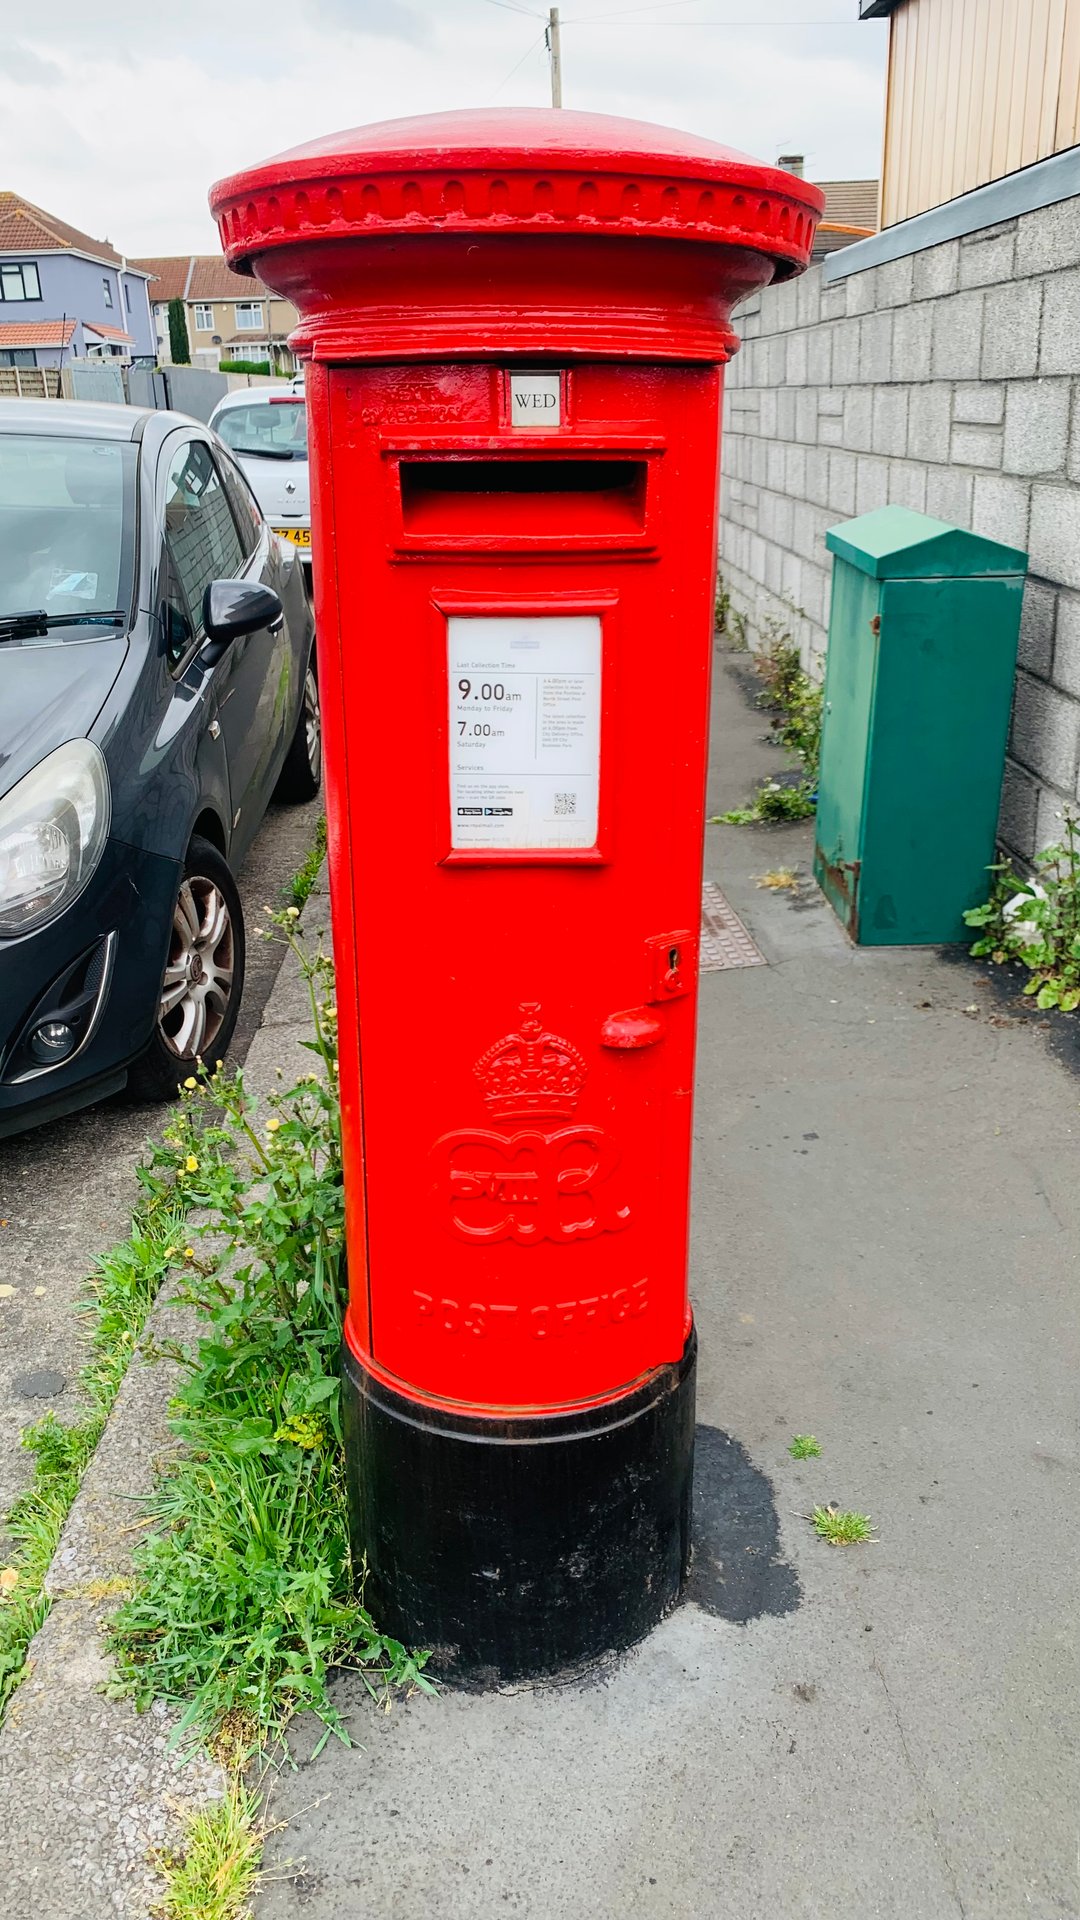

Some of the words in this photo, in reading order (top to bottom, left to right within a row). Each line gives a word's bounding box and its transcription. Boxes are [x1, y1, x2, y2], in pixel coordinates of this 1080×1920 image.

[514, 393, 556, 409] WED
[293, 530, 311, 543] 45
[458, 678, 522, 701] 9.00am
[457, 705, 482, 713] Monday
[493, 705, 513, 713] Friday
[457, 721, 505, 737] 7.00am
[457, 740, 487, 749] Saturday
[412, 1289, 519, 1341] POST
[530, 1277, 649, 1341] OFFICE
